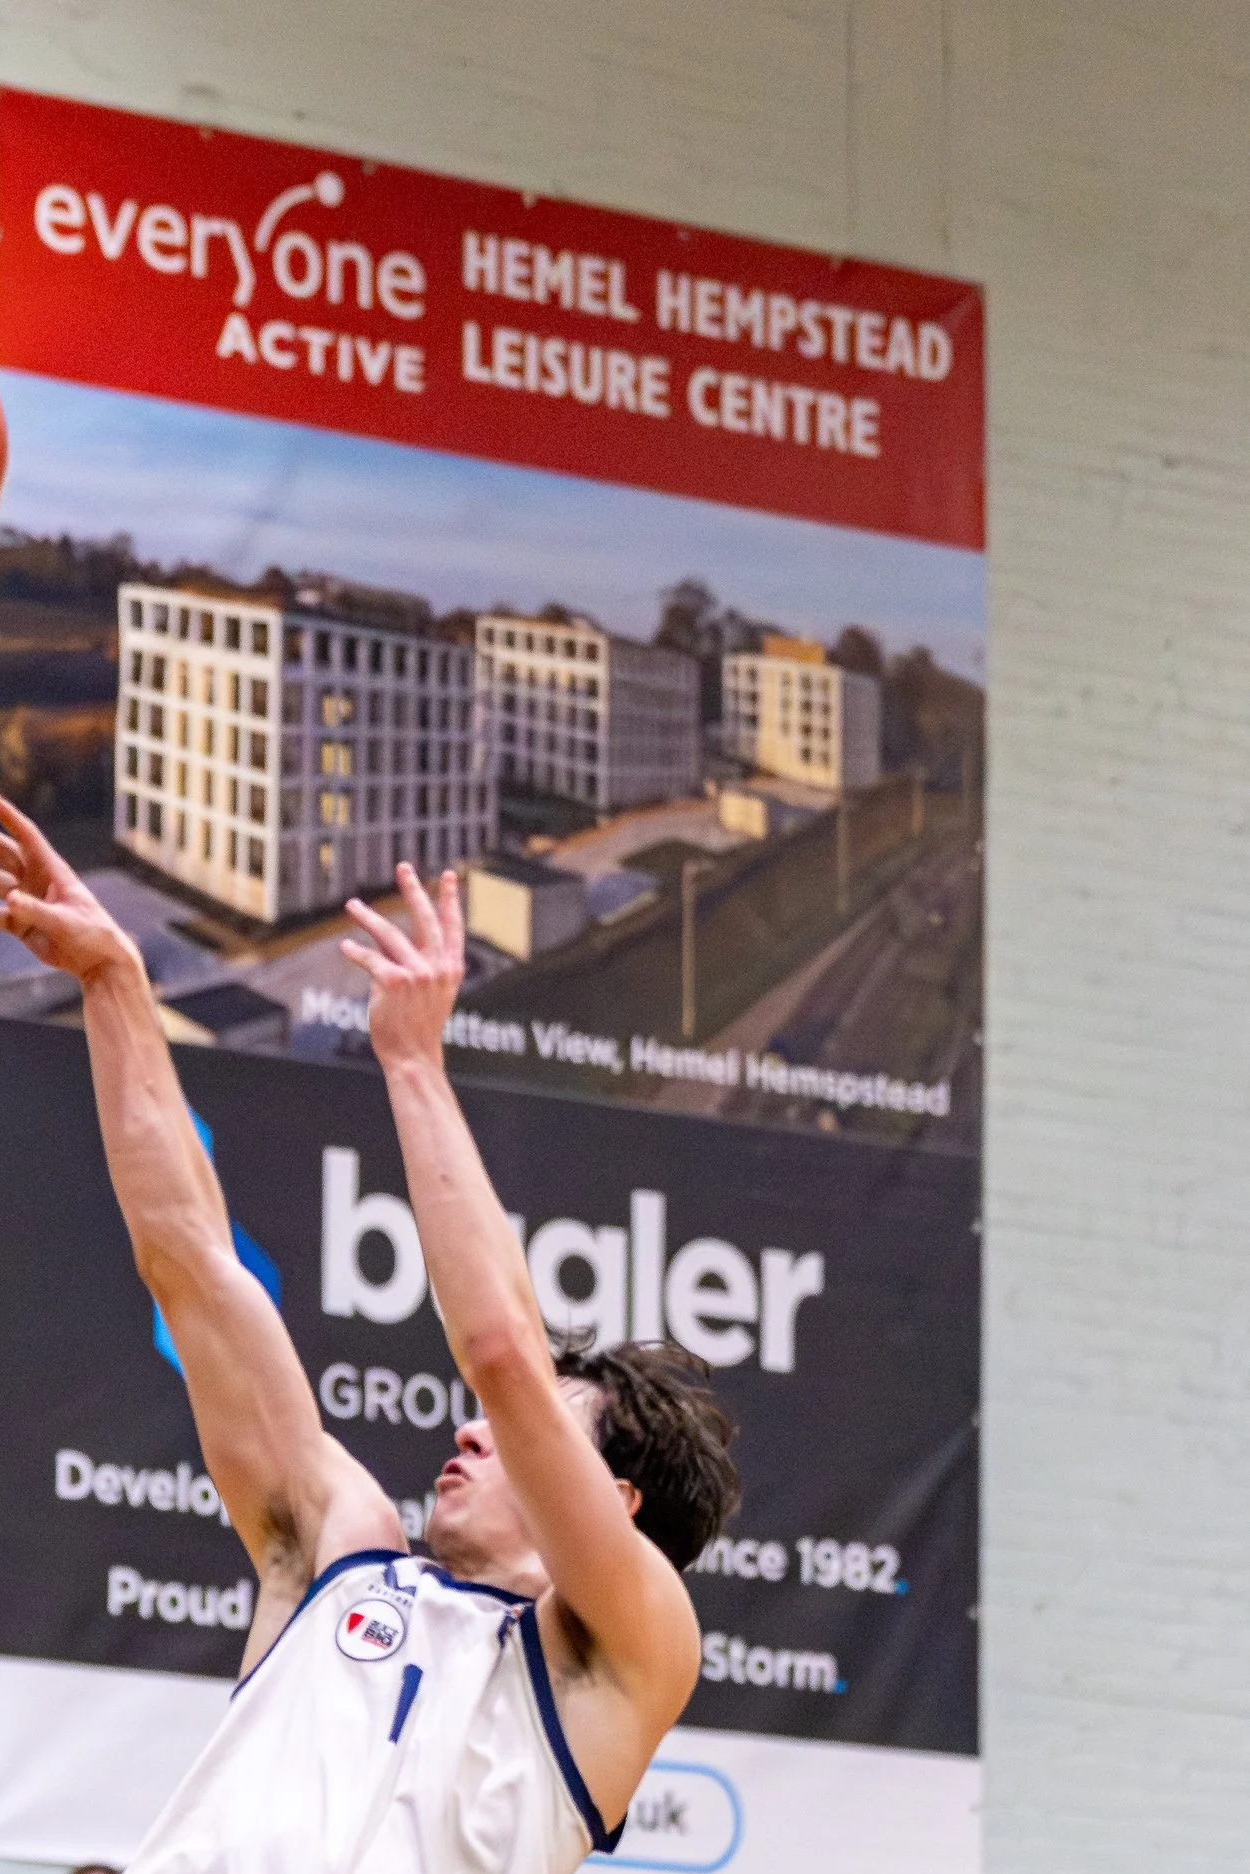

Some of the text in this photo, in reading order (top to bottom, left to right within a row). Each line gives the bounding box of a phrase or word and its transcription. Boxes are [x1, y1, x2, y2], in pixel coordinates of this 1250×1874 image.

[34, 172, 954, 384] everyone HEMEL HEMPSTEAD
[215, 312, 425, 394] ACTIVE
[462, 320, 881, 458] LEISURE CENTRE
[302, 986, 527, 1056] Mouatten
[531, 1022, 623, 1075] View,
[631, 1034, 739, 1086] Hemel
[320, 1146, 825, 1374] bgler
[318, 1361, 485, 1431] GROU
[688, 1536, 788, 1582] ince
[107, 1564, 847, 1694] Proud Storm.
[388, 1663, 424, 1744] 1
